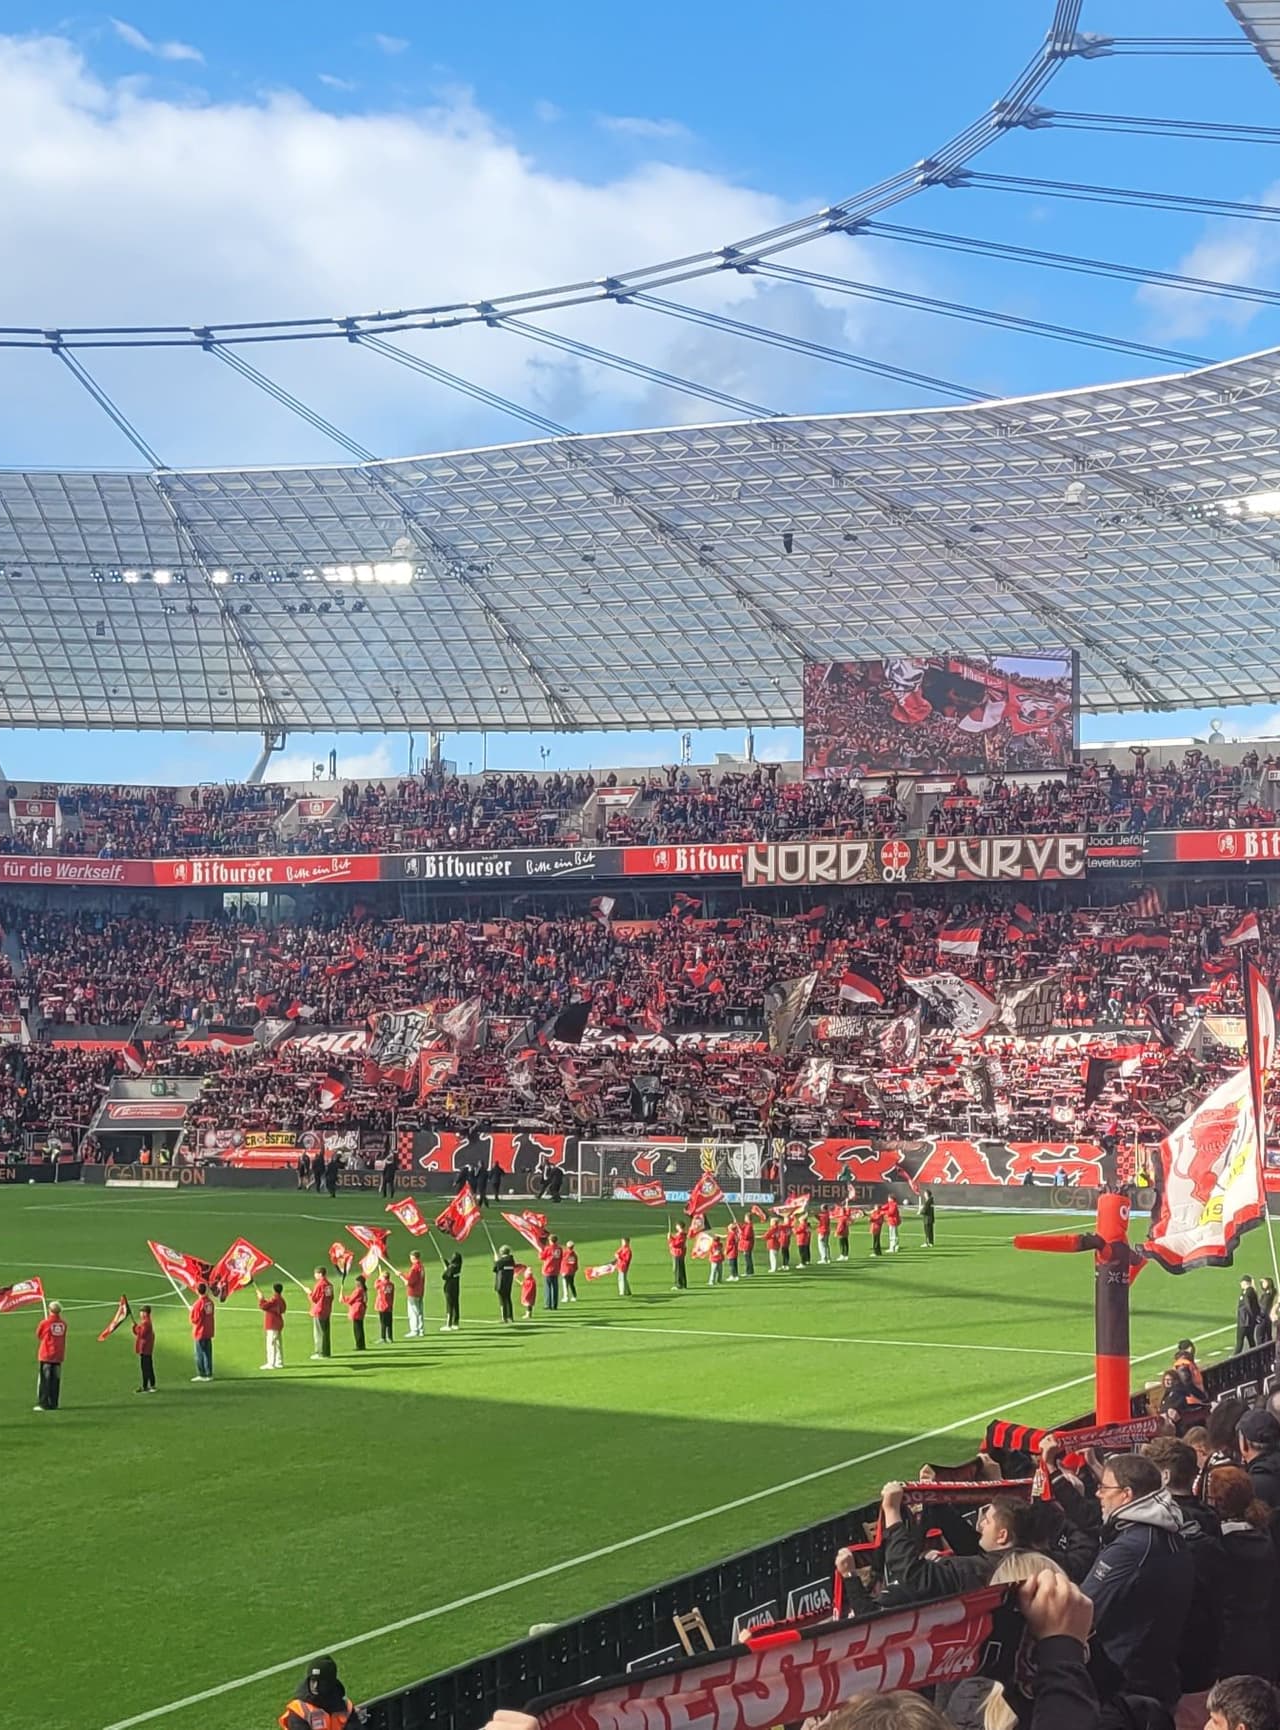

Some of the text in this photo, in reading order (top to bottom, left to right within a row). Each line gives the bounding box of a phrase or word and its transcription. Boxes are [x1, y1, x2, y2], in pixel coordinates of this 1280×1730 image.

[4, 861, 26, 878] für
[30, 862, 53, 879] die
[55, 863, 126, 881] Werkself.
[191, 861, 273, 884] Bitburger
[312, 864, 330, 876] ein
[331, 858, 351, 872] Bit
[424, 855, 512, 878] Bitburger
[553, 859, 573, 870] ein
[574, 851, 596, 865] Bit
[675, 847, 744, 872] Bitbur
[747, 837, 1085, 883] NORD KURVE
[1087, 858, 1142, 869] Leverkusen
[882, 867, 907, 882] 04
[141, 1167, 206, 1185] DITCON
[588, 1598, 976, 1730] MEISTER 2024
